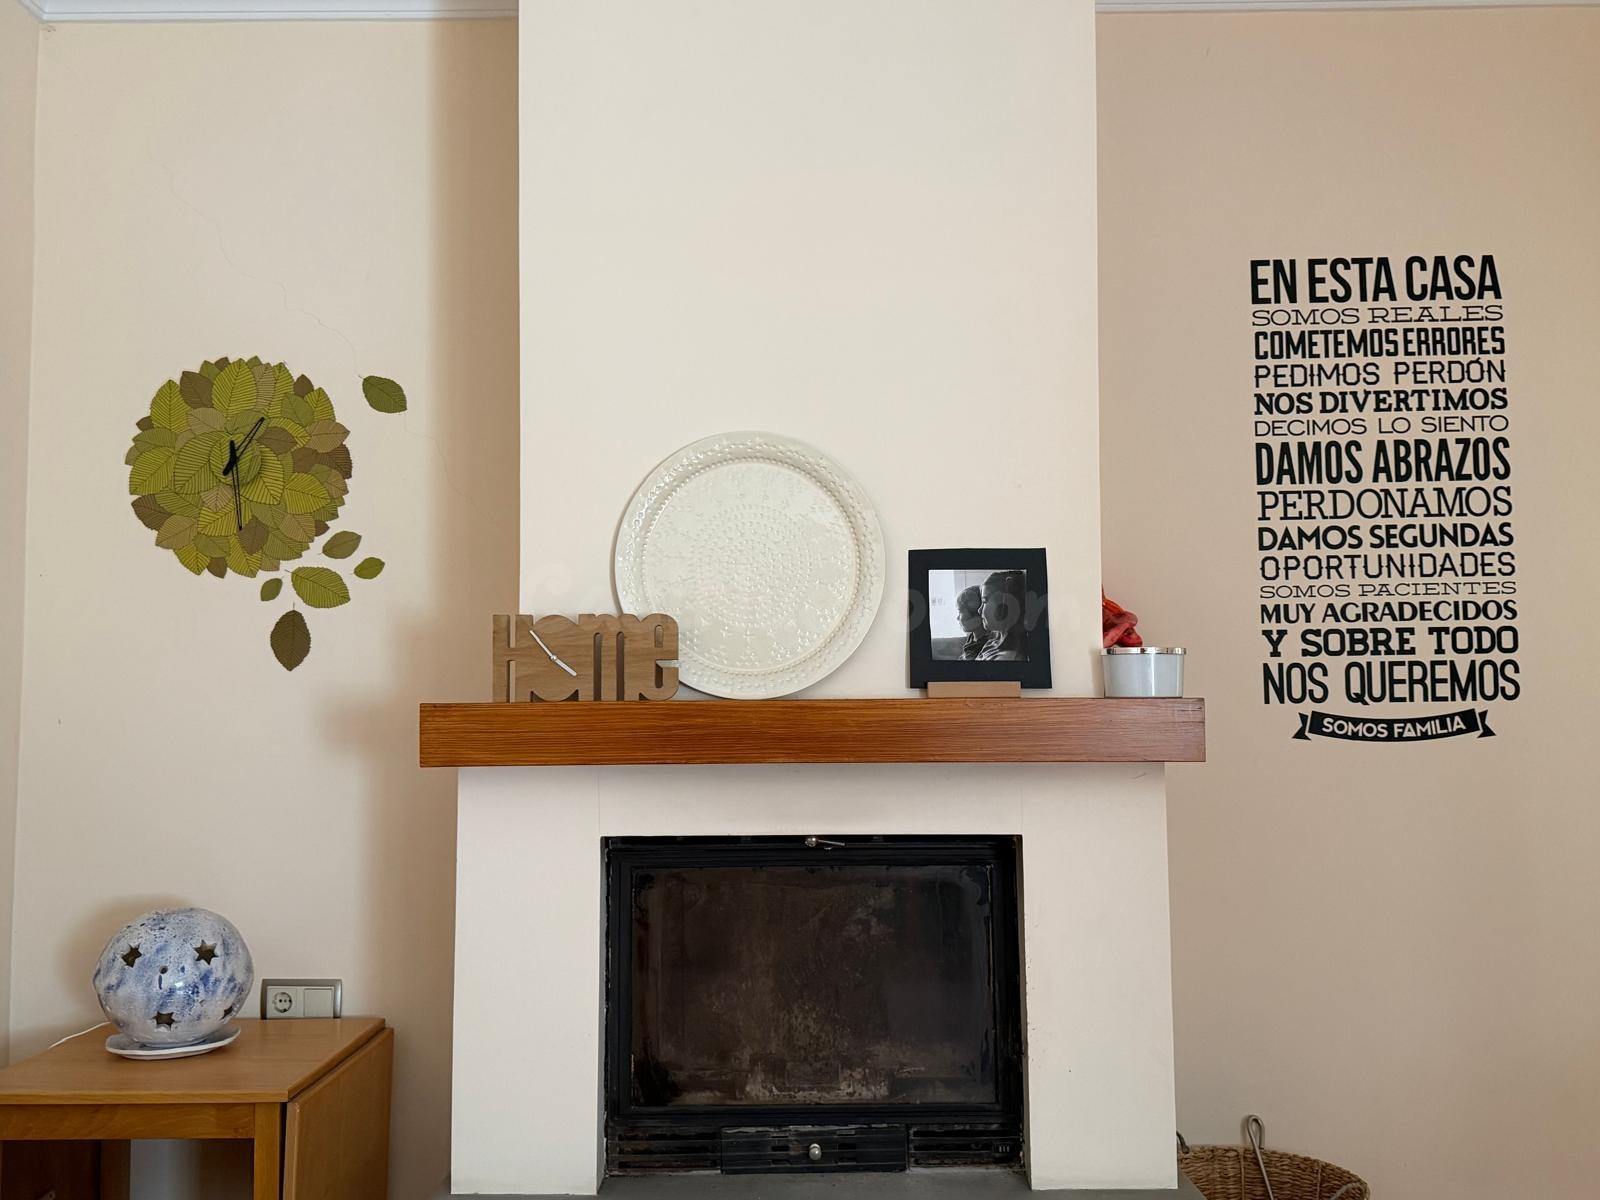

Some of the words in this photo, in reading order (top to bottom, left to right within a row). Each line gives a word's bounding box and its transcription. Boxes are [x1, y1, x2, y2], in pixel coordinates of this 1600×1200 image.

[1250, 258, 1298, 305] EN
[1307, 256, 1398, 304] ESTA
[1405, 254, 1503, 302] CASA
[1251, 308, 1360, 327] SOMOS
[1367, 304, 1504, 324] REALES
[1254, 328, 1399, 360] COMETEMOS
[1402, 325, 1506, 357] ERRORES
[1254, 362, 1380, 388] PEDIMOS
[1393, 357, 1506, 385] PERDÓN
[1254, 392, 1313, 415] NOS
[1319, 387, 1508, 414] DIVERTIMOS
[1254, 418, 1367, 437] DECIMOS
[1378, 417, 1411, 434] LO
[1421, 415, 1509, 434] SIENTO
[1255, 440, 1364, 486] DAMOS
[1371, 436, 1511, 483] ABRAZOS
[1257, 486, 1513, 521] PERDONAMOS
[1257, 524, 1363, 552] DAMOS
[1369, 521, 1514, 549] SEGUNDAS
[1260, 551, 1516, 581] OPORTUNIDADES
[1259, 584, 1351, 599] SOMOS
[1357, 581, 1517, 597] PACIENTES
[1260, 603, 1316, 624] MUY
[1322, 600, 1518, 623] AGRADECIDOS
[1261, 629, 1288, 658] Y
[1300, 627, 1416, 658] SOBRE
[1428, 625, 1520, 655] TODO
[1262, 661, 1329, 705] NOS
[1344, 659, 1521, 706] QUEREMOS
[1322, 717, 1389, 738] SOMOS
[1393, 715, 1466, 738] FAMILIA
